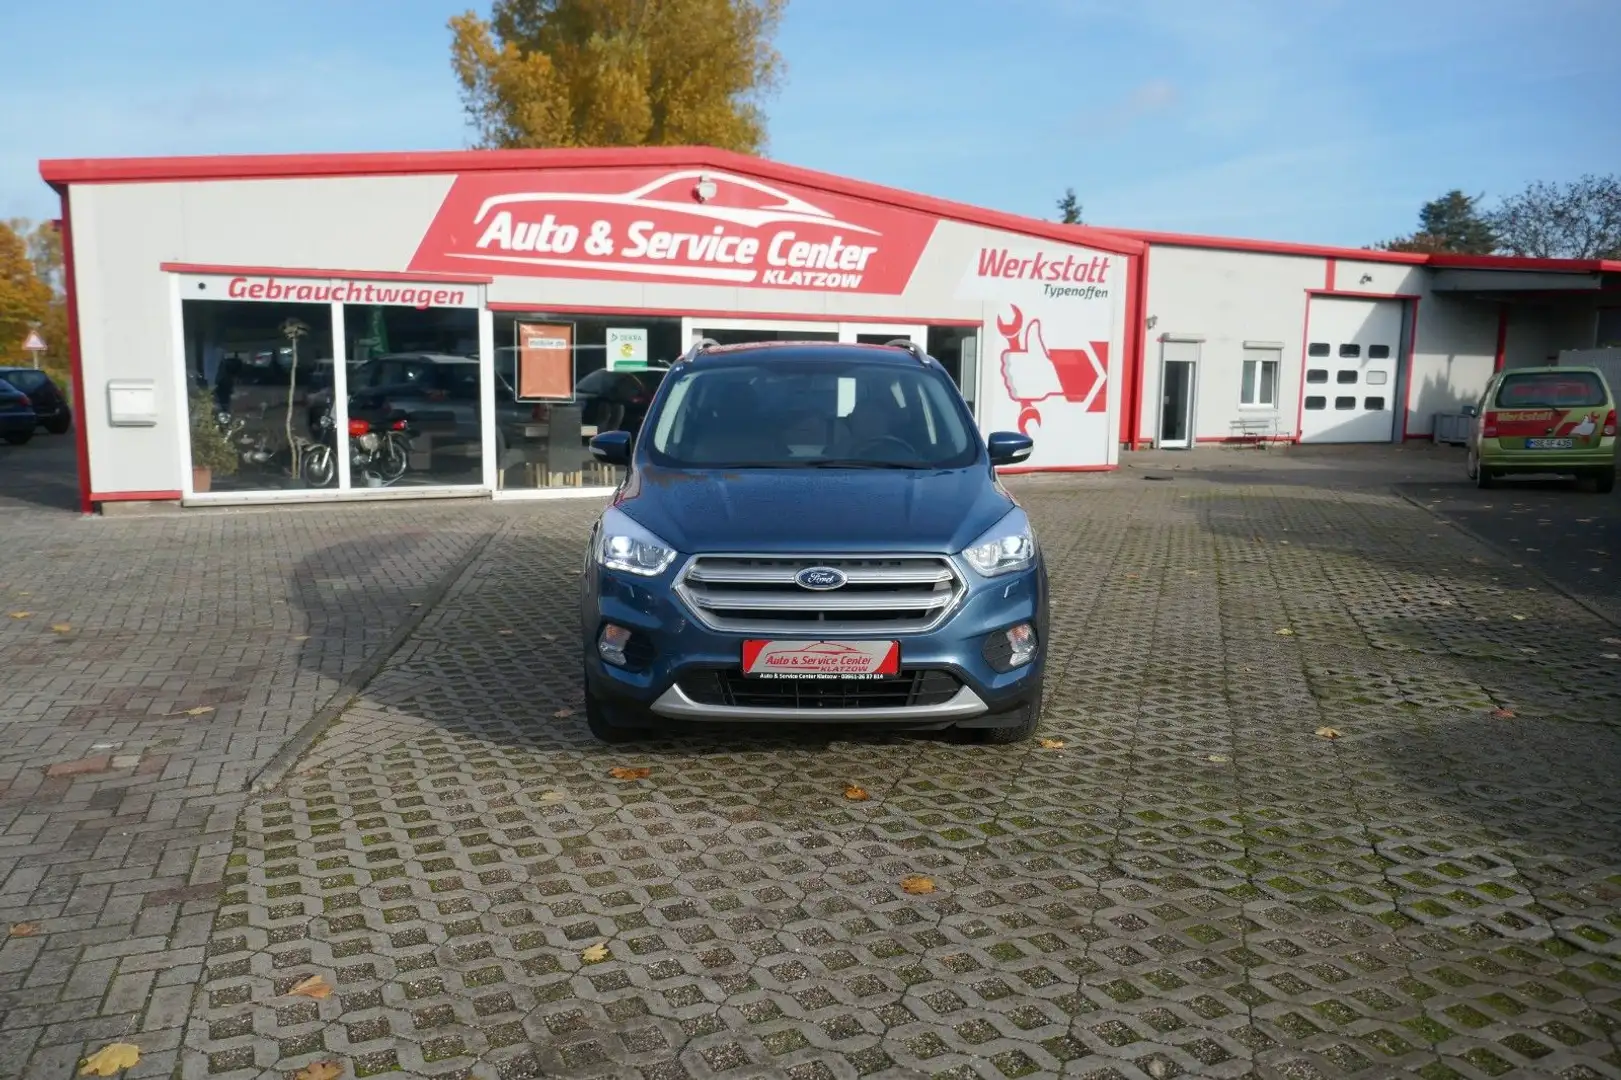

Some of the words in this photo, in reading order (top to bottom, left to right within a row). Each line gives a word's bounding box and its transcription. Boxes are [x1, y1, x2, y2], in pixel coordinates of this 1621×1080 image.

[476, 211, 579, 253] Auto
[584, 220, 614, 256] &
[621, 220, 760, 264] Service
[767, 230, 878, 271] Center
[978, 247, 1110, 283] Werkstatt
[762, 269, 863, 289] KLATZOW
[228, 276, 464, 310] Gebrauchtwagen
[1043, 283, 1108, 299] Typenoffen
[807, 572, 835, 584] Ford
[766, 656, 790, 665] Auto
[791, 656, 798, 665] &
[800, 656, 837, 665] Service
[840, 656, 872, 665] Center
